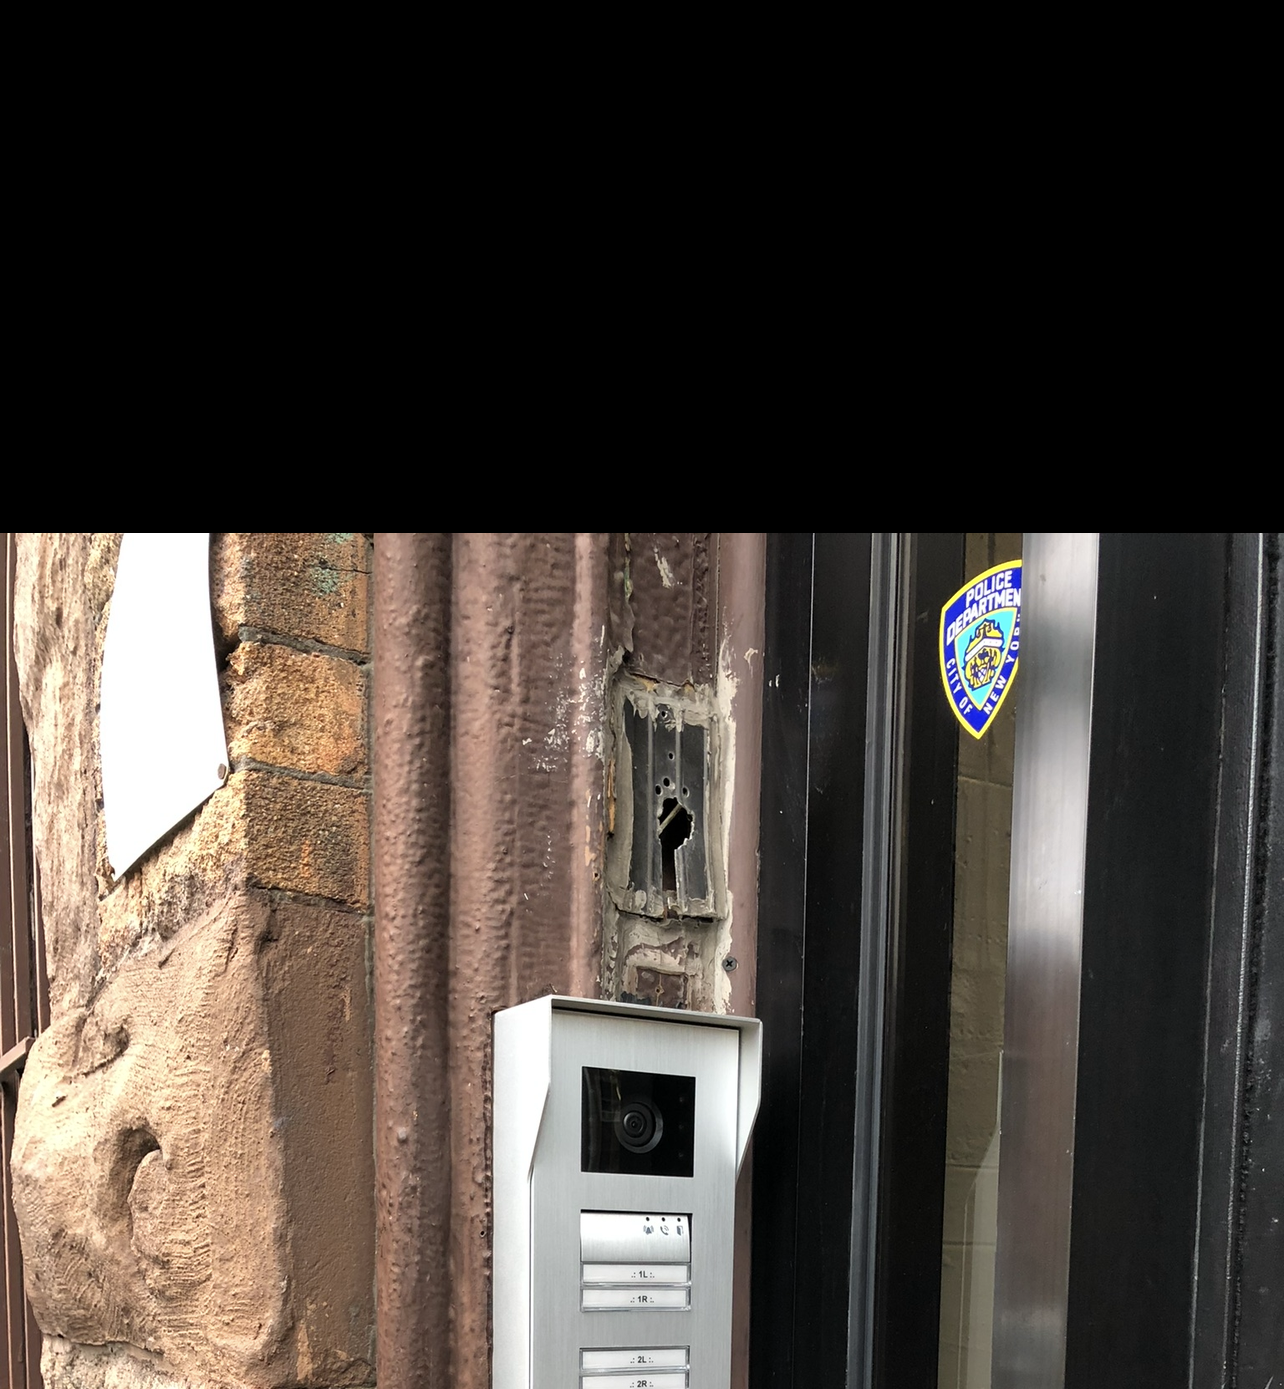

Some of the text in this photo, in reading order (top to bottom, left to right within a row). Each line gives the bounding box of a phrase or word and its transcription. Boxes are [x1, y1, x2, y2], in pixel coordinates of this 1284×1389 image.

[965, 570, 1013, 608] POLICE
[946, 588, 1021, 646] DEPARTMEN
[946, 658, 963, 694] CITY
[959, 697, 973, 715] OF
[983, 675, 1007, 715] NEW
[637, 1295, 648, 1304] 1R
[637, 1356, 647, 1364] 2L
[636, 1380, 648, 1388] 2R
